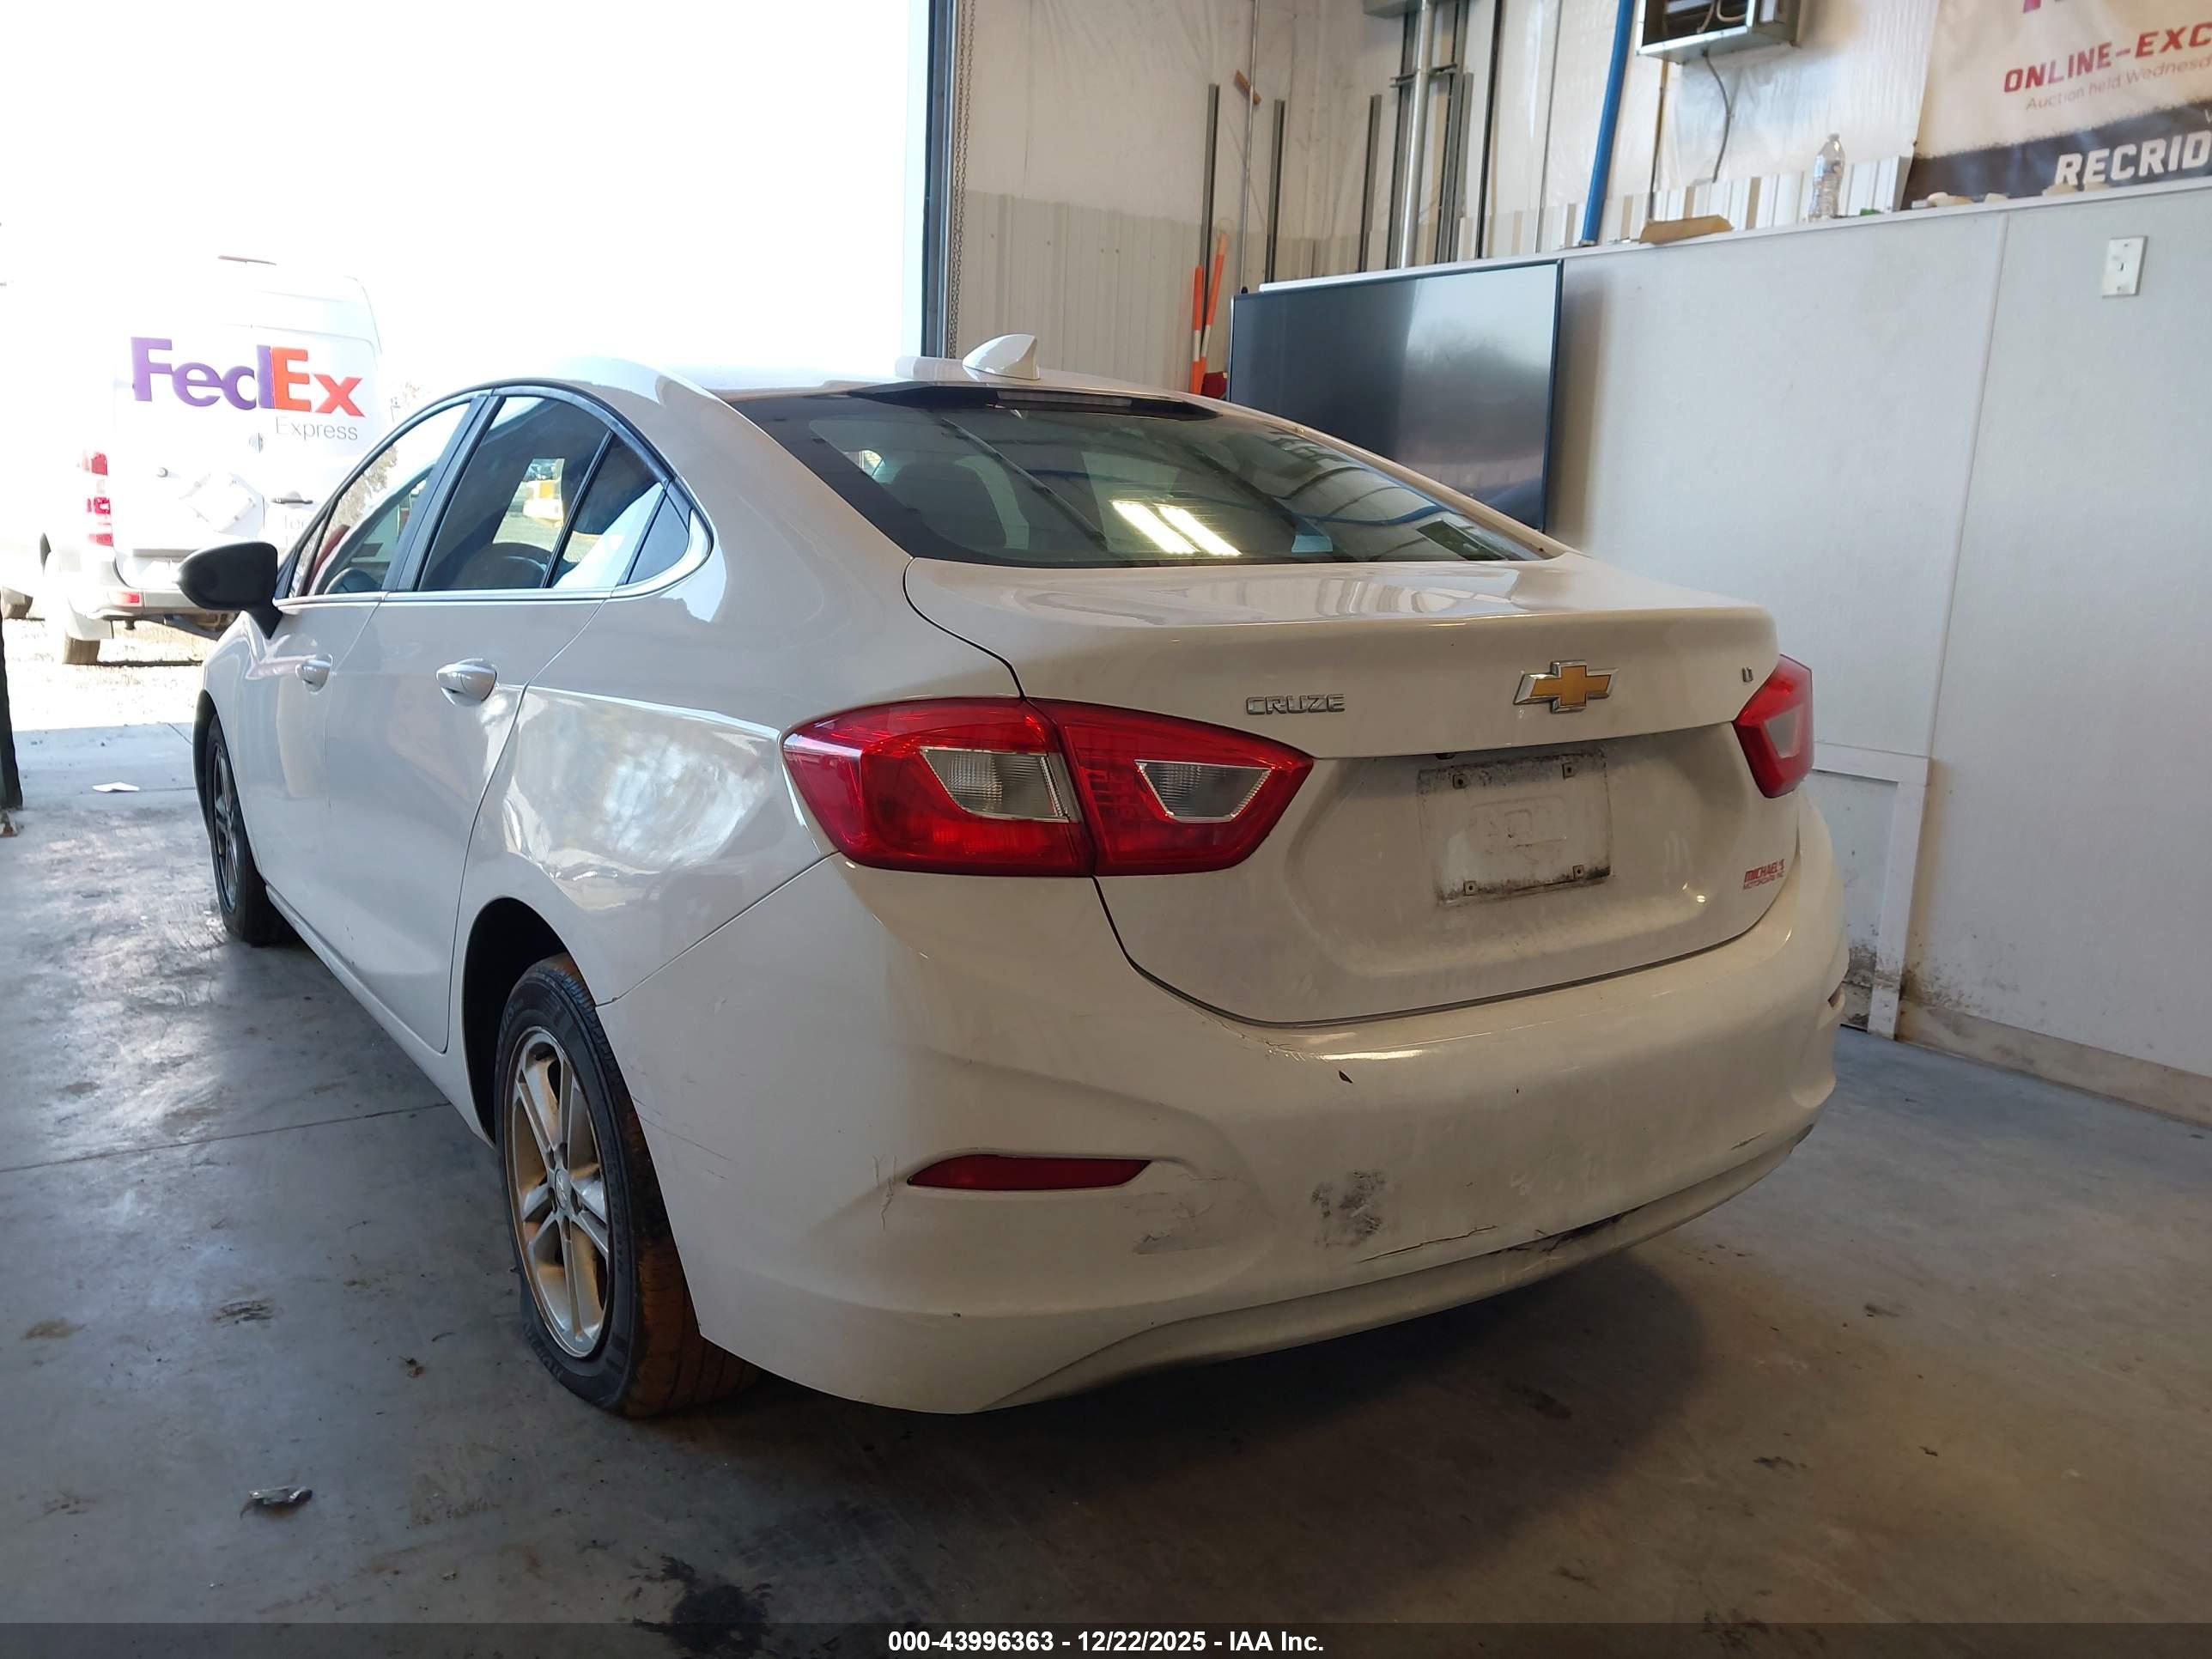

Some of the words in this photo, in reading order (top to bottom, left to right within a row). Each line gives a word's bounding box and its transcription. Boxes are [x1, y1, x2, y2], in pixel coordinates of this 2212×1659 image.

[2026, 87, 2085, 110] Auction
[2088, 74, 2121, 96] held
[2054, 130, 2212, 185] RECRID
[131, 337, 366, 418] FedEx
[276, 416, 358, 441] Express
[1246, 694, 1346, 715] CRUZE
